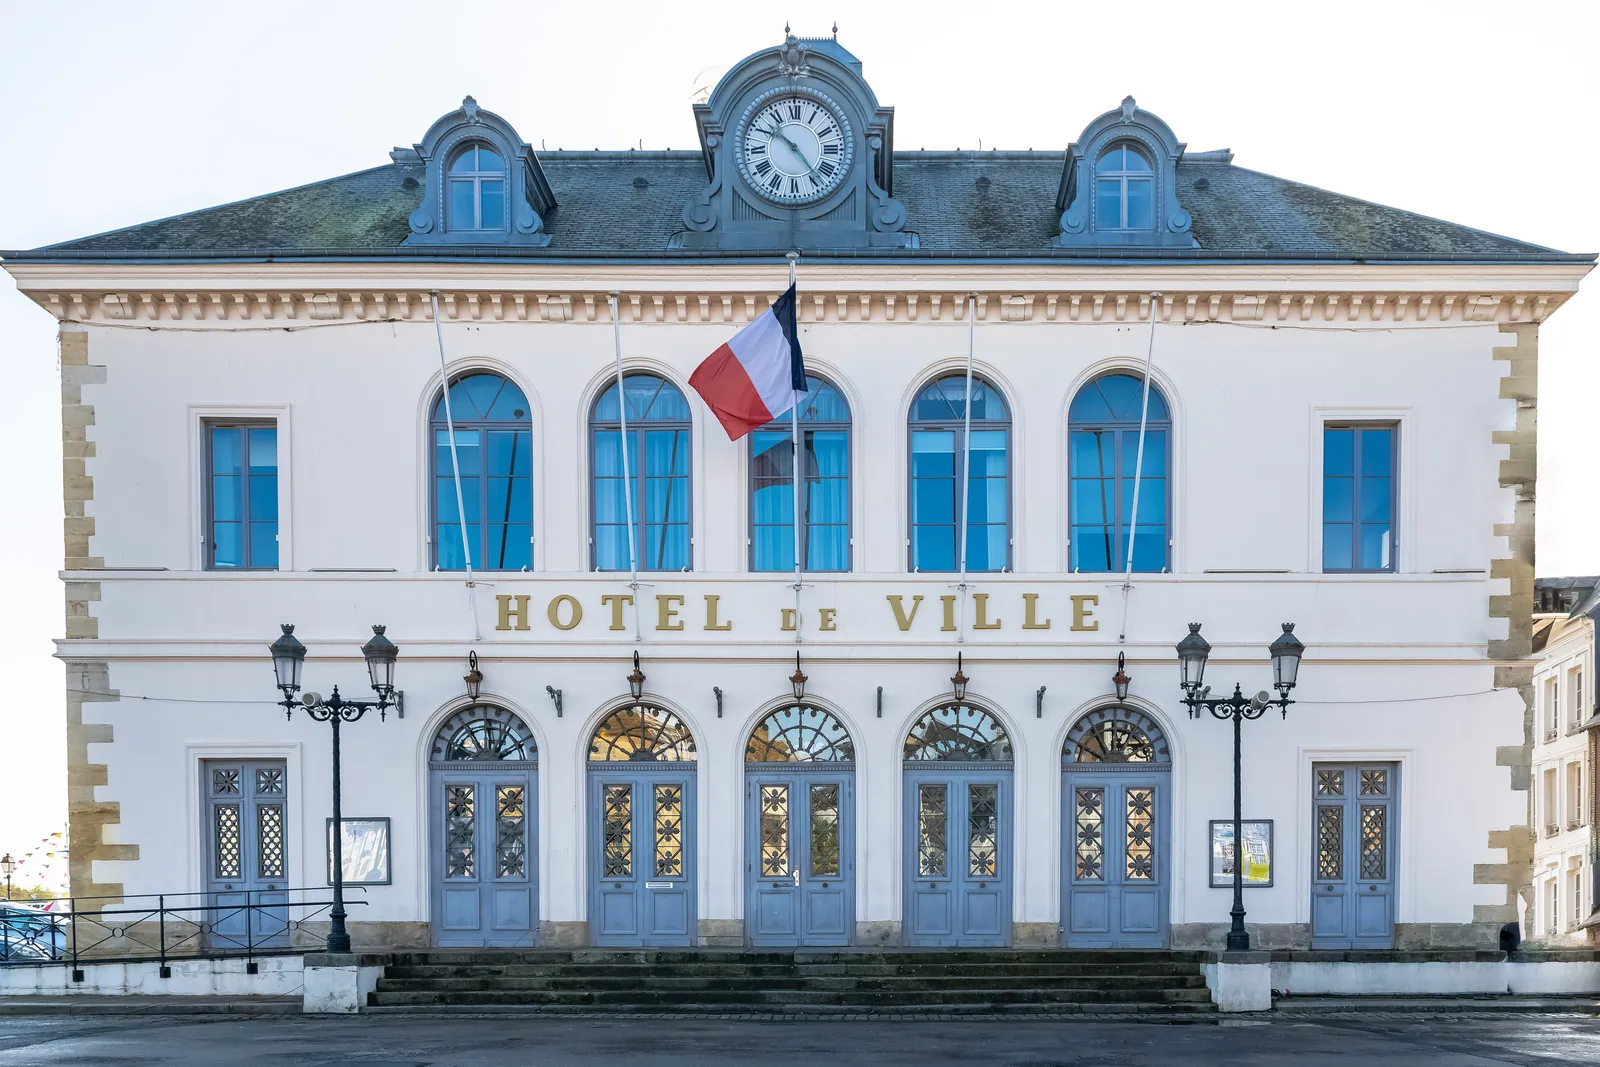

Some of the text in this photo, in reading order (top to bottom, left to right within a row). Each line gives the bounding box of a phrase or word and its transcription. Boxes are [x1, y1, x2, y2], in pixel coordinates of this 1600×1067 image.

[788, 105, 801, 120] XII
[495, 593, 1099, 632] HOTEL DE VILLE
